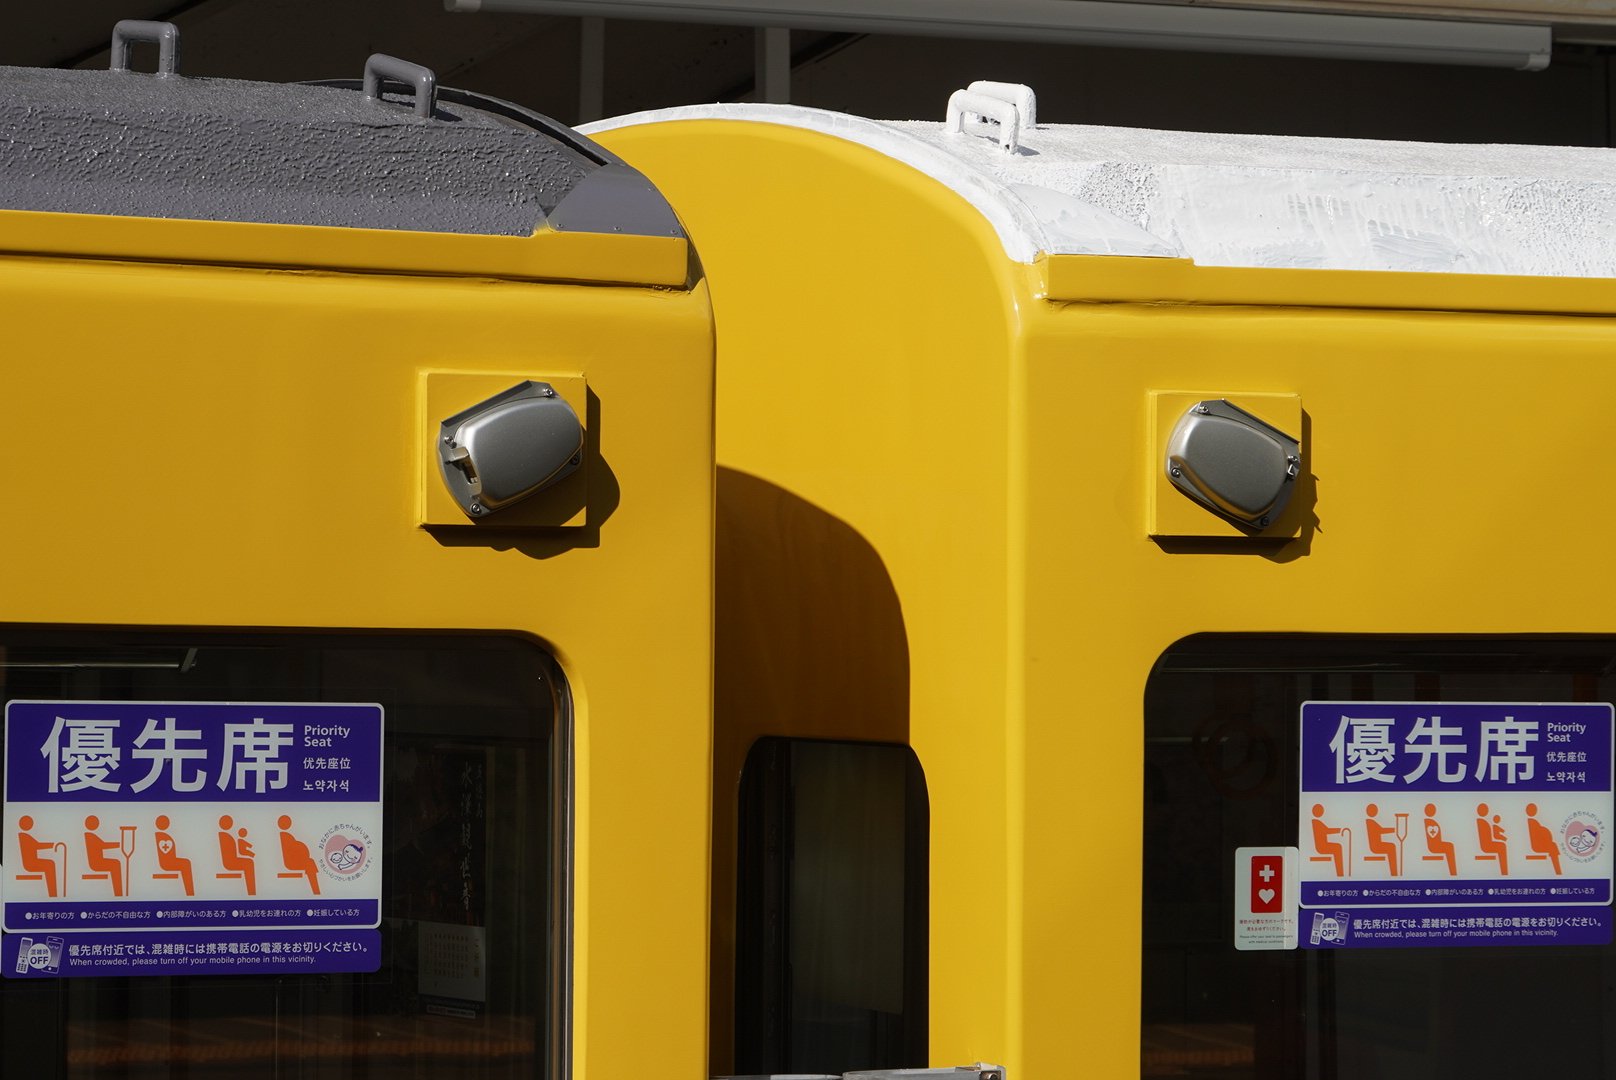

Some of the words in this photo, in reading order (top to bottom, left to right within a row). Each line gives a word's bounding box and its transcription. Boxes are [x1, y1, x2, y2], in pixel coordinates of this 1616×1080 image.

[303, 724, 351, 739] Priority
[1547, 722, 1587, 735] Priority
[303, 736, 332, 748] Seat
[1547, 732, 1572, 743] Seat
[40, 716, 294, 793] 優先席
[1329, 715, 1539, 785] 優先席
[1546, 751, 1588, 763] 优先座位
[303, 757, 351, 770] 优先座位
[1546, 771, 1586, 783] 노약자석
[303, 779, 350, 793] 노약자석
[1322, 929, 1337, 937] OFF
[1374, 931, 1404, 939] crowded,
[1405, 931, 1428, 939] please
[1492, 930, 1513, 938] phone
[1535, 929, 1559, 938] vicinity.
[30, 956, 49, 965] OFF
[69, 958, 92, 966] When
[94, 958, 130, 966] crowded,
[132, 958, 158, 968] please
[160, 957, 176, 965] turn
[177, 957, 188, 965] off
[190, 958, 207, 967] your
[209, 956, 235, 964] mobile
[237, 957, 261, 965] phone
[272, 956, 286, 964] this
[288, 955, 316, 965] vicinity.
